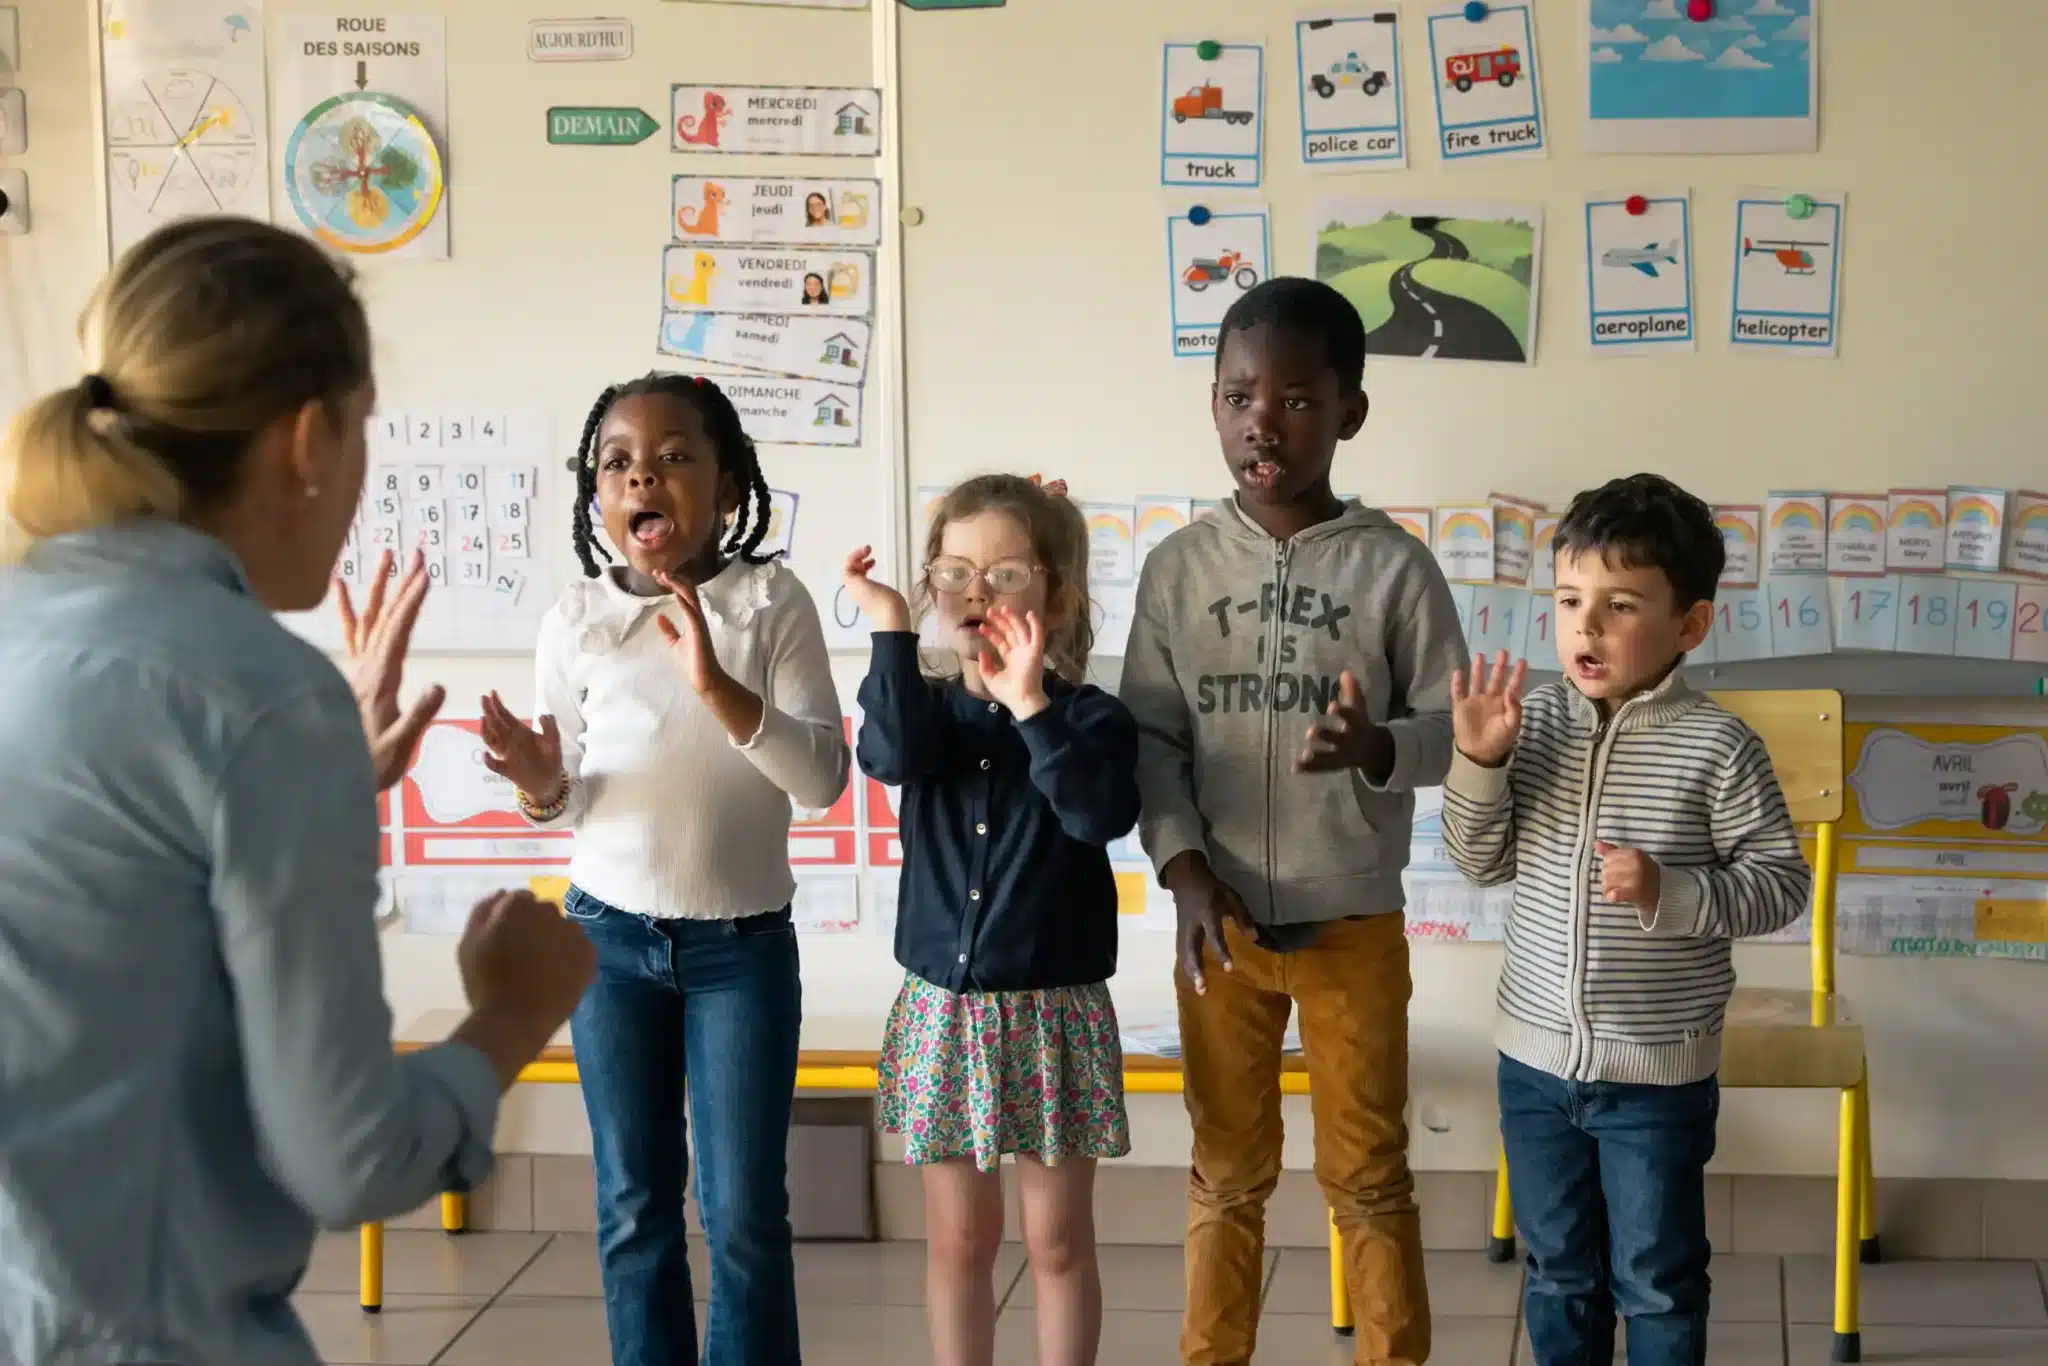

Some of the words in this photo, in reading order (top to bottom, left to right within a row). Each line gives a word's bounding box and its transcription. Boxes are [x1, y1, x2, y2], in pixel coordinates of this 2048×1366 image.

[337, 18, 386, 33] ROUE
[304, 42, 337, 56] DES
[343, 42, 420, 57] SAISONS
[748, 97, 817, 110] MERCREDI
[553, 115, 641, 136] DEMAIN
[748, 114, 803, 126] mercredi
[1308, 136, 1359, 158] police
[1367, 135, 1396, 151] car
[1446, 131, 1480, 150] fire
[1488, 125, 1536, 143] truck
[1185, 161, 1236, 179] truck
[752, 184, 793, 197] JEUDI
[752, 203, 784, 217] jeudi
[738, 258, 807, 270] VENDREDI
[738, 277, 793, 289] vendredi
[1596, 315, 1687, 338] aeroplane
[1737, 318, 1828, 342] helicopter
[736, 329, 780, 345] samedi
[728, 386, 801, 400] DIMANCHE
[387, 422, 395, 438] 1
[419, 422, 430, 438] 2
[451, 422, 462, 438] 3
[483, 420, 495, 438] 4
[386, 474, 397, 490] 8
[419, 474, 430, 491] 9
[457, 473, 478, 489] 10
[511, 472, 525, 488] 11
[375, 498, 395, 515] 15
[420, 506, 439, 522] 16
[461, 504, 479, 520] 17
[501, 503, 521, 519] 18
[374, 527, 394, 543] 22
[419, 528, 440, 545] 23
[461, 535, 483, 551] 24
[499, 532, 522, 551] 25
[1208, 583, 1351, 641] T-REX
[1477, 605, 1513, 636] 11
[1535, 611, 1548, 641] 1
[1720, 600, 1760, 633] 15
[1778, 596, 1820, 629] 16
[1849, 590, 1892, 621] 17
[1908, 593, 1949, 627] 18
[1966, 599, 2008, 630] 19
[1257, 635, 1297, 664] IS
[1932, 754, 1976, 773] AVRIL
